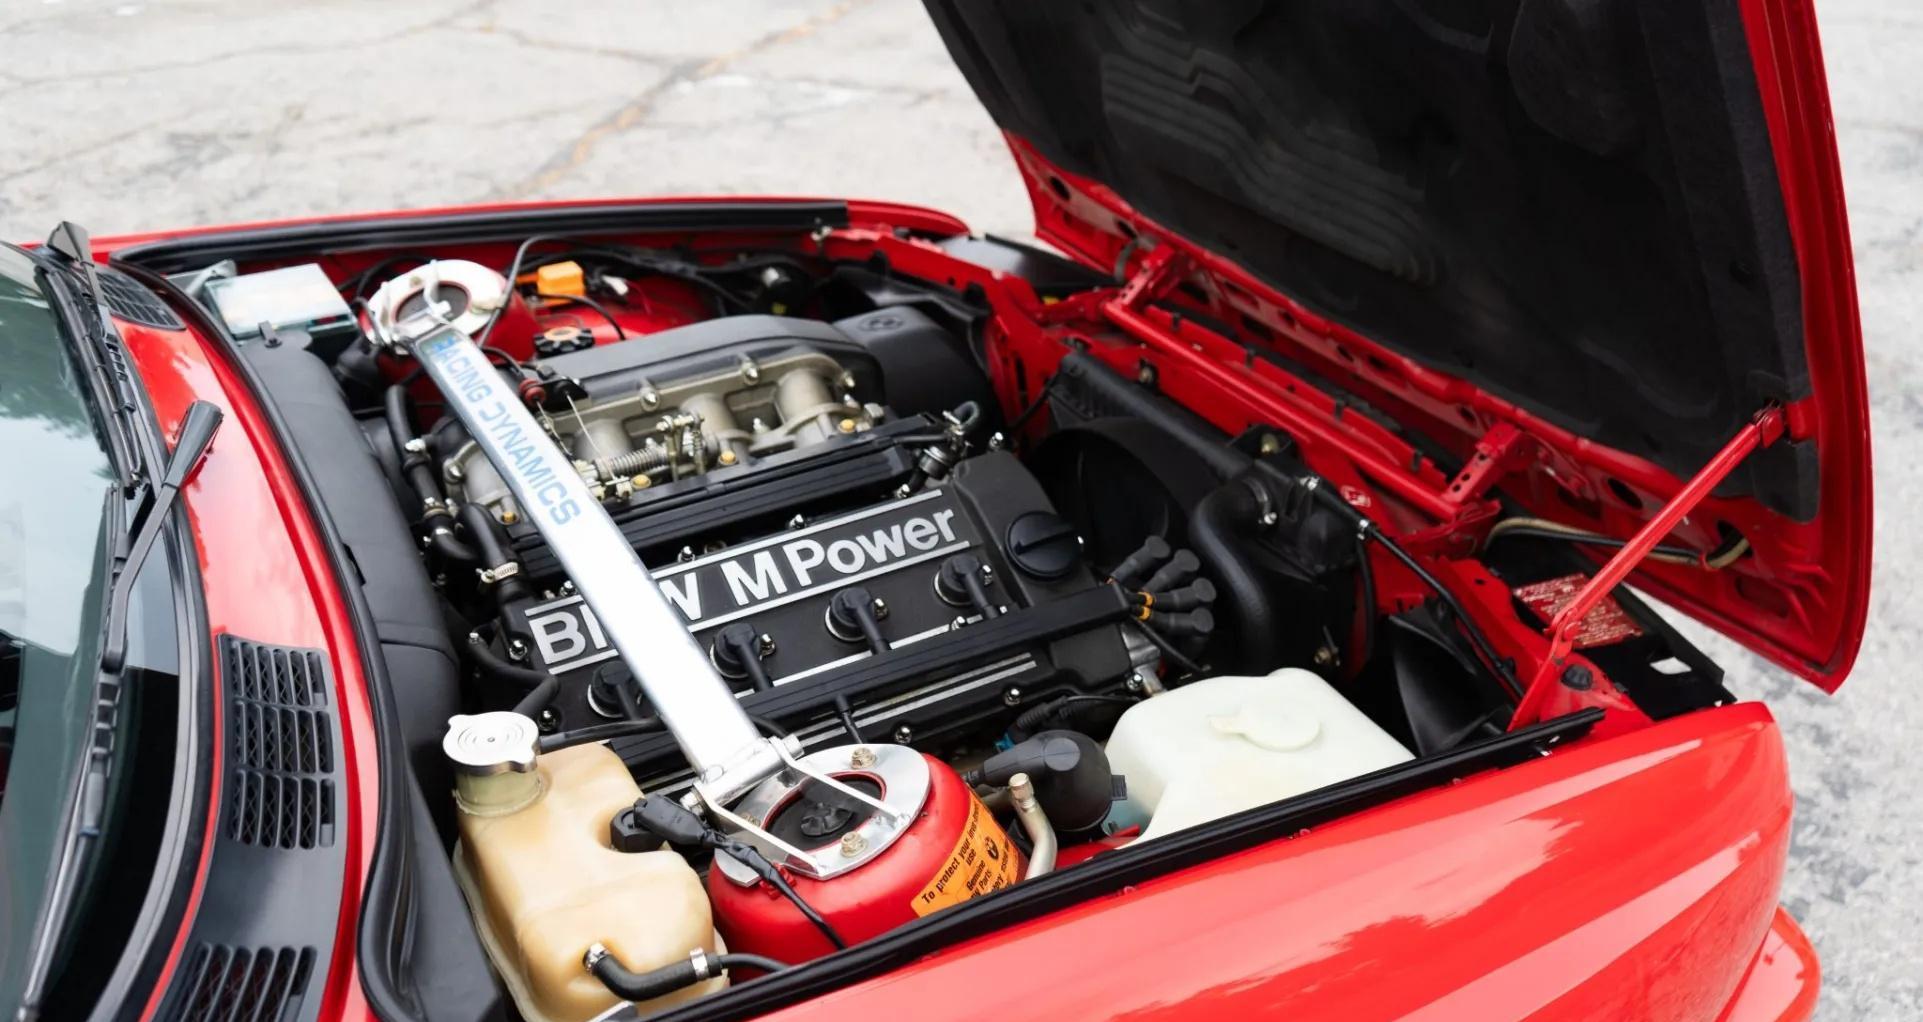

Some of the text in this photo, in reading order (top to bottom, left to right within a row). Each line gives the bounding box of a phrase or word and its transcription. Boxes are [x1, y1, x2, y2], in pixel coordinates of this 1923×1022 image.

[529, 571, 703, 665] BW
[921, 839, 972, 905] To protect your
[965, 848, 978, 867] use
[966, 859, 986, 892] Genuine
[978, 868, 993, 890] Parts
